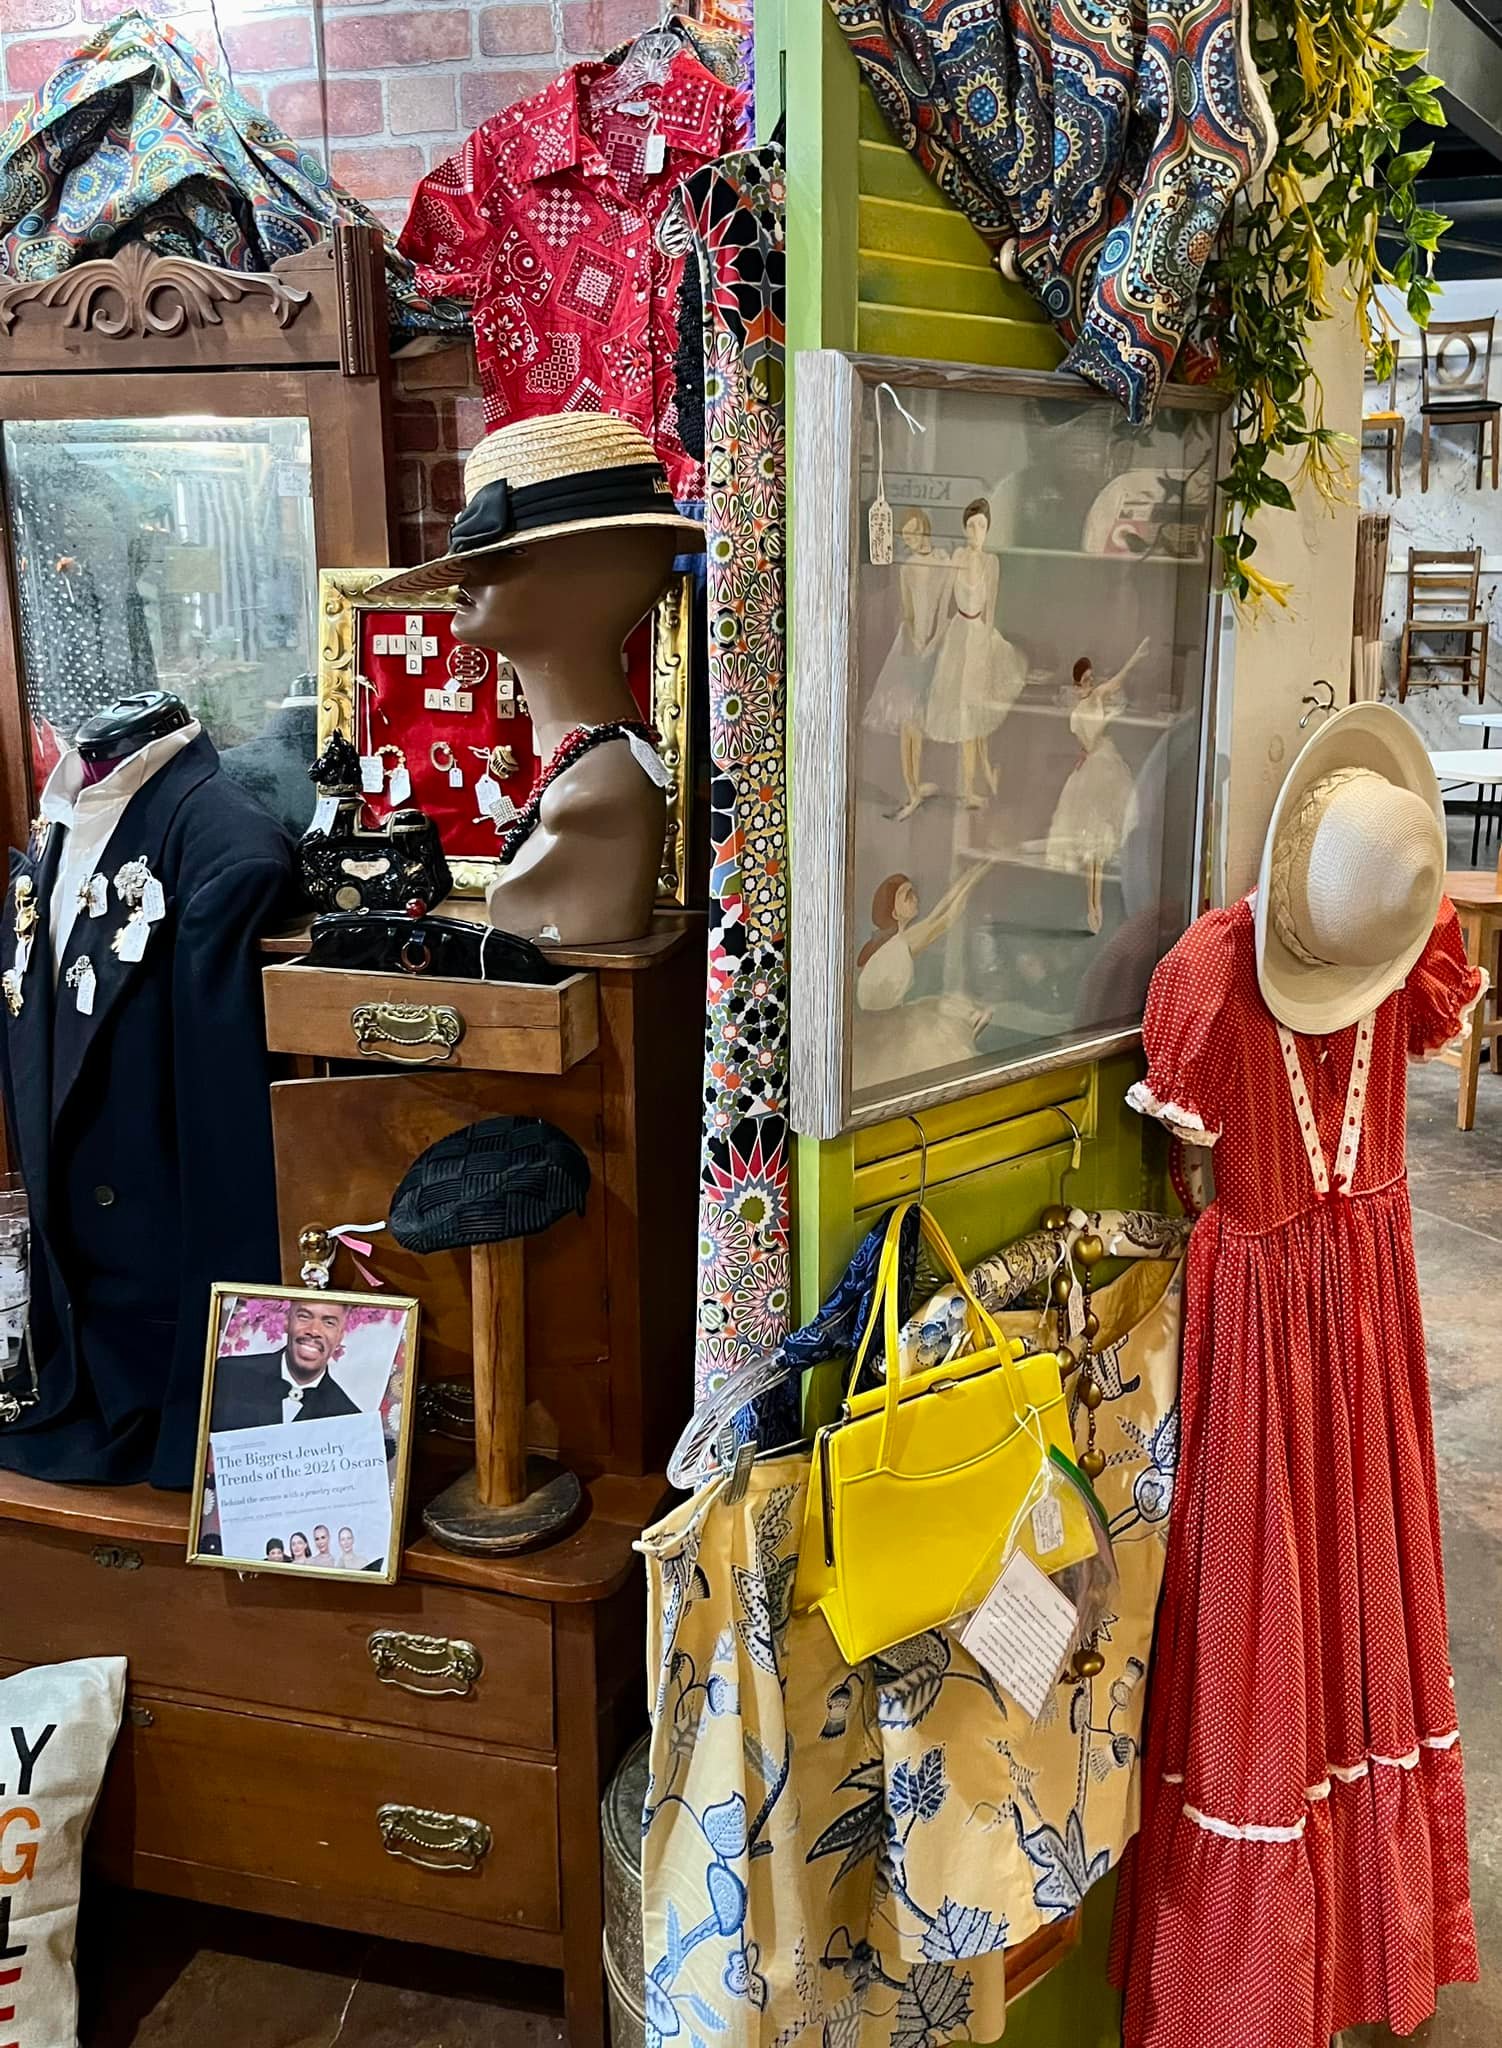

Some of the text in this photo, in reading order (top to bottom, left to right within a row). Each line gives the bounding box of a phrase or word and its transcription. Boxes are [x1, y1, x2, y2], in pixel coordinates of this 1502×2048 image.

[375, 638, 434, 653] PINS
[427, 692, 469, 709] ARE
[216, 1441, 345, 1470] The Biggest Jewelry
[217, 1456, 385, 1487] Trends of the 2024 Oscars
